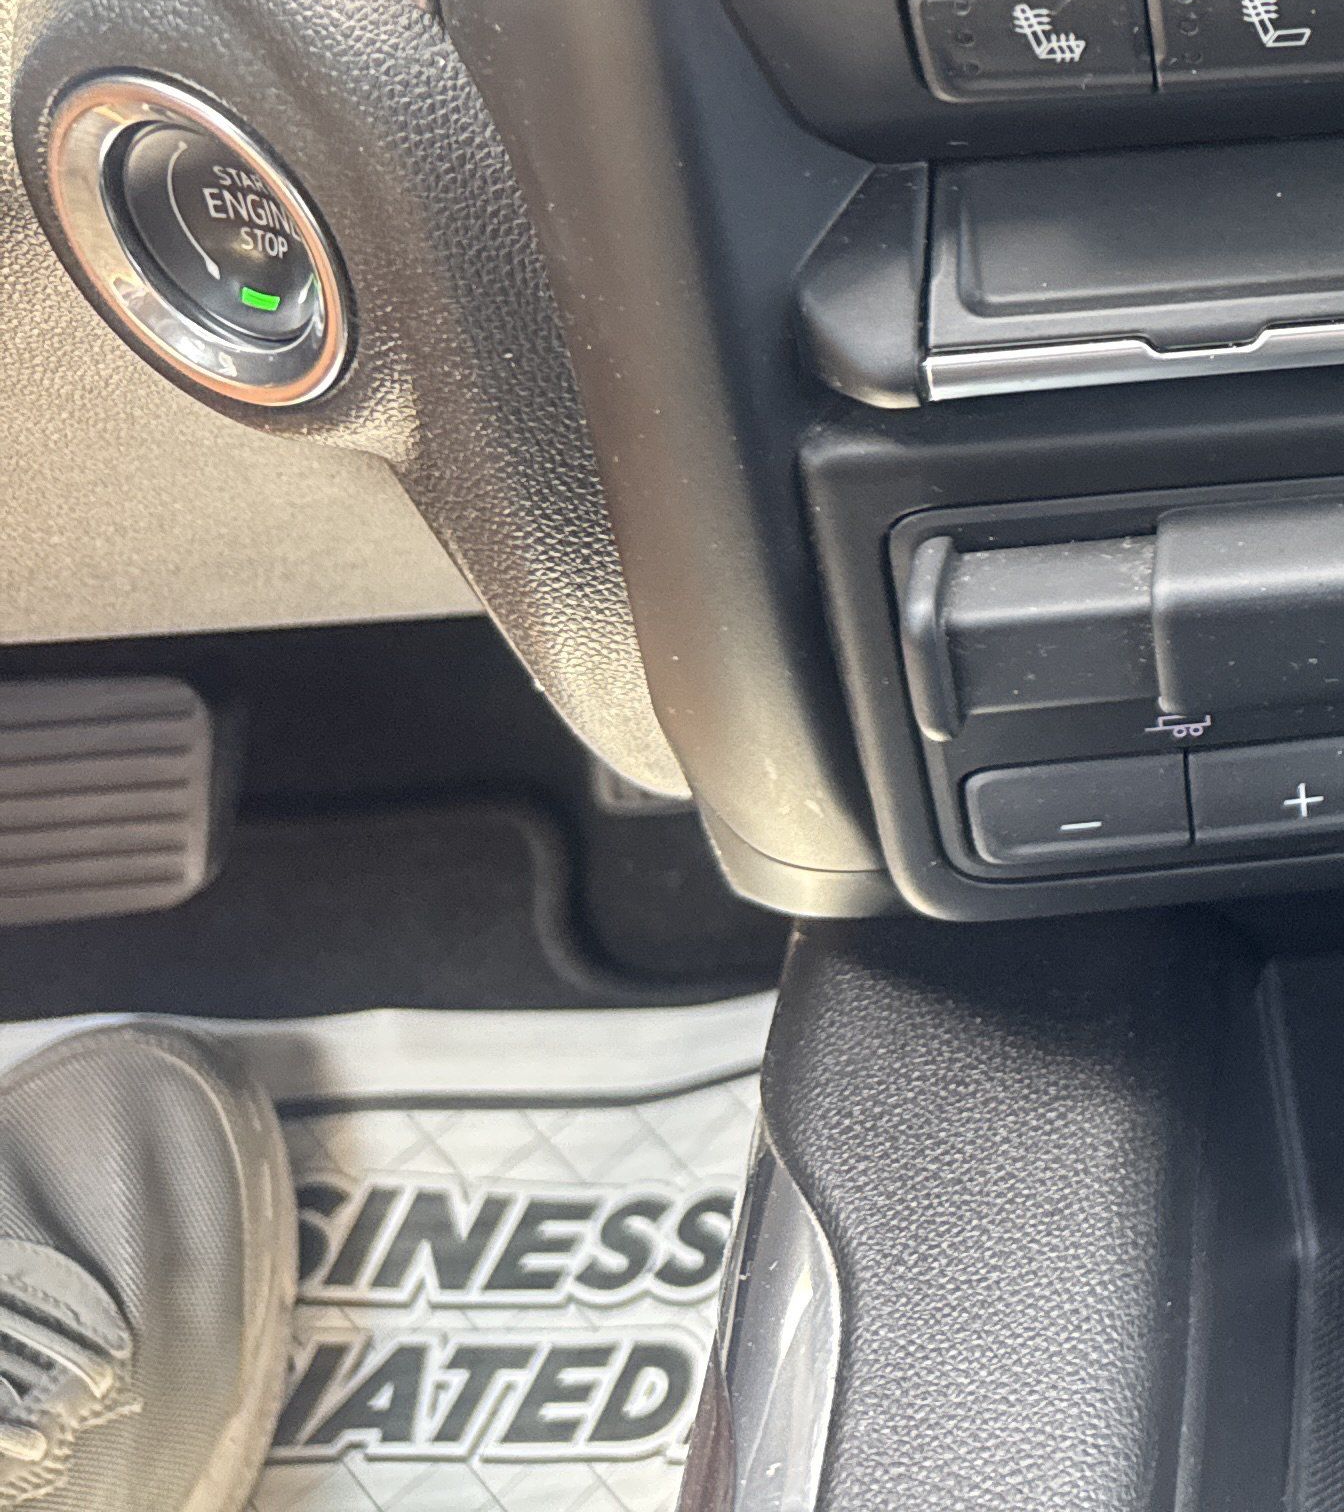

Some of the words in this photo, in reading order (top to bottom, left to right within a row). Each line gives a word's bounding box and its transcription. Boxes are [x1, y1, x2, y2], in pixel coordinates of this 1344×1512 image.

[212, 165, 269, 195] STAR
[240, 226, 288, 259] STOP
[268, 1341, 694, 1445] IATED
